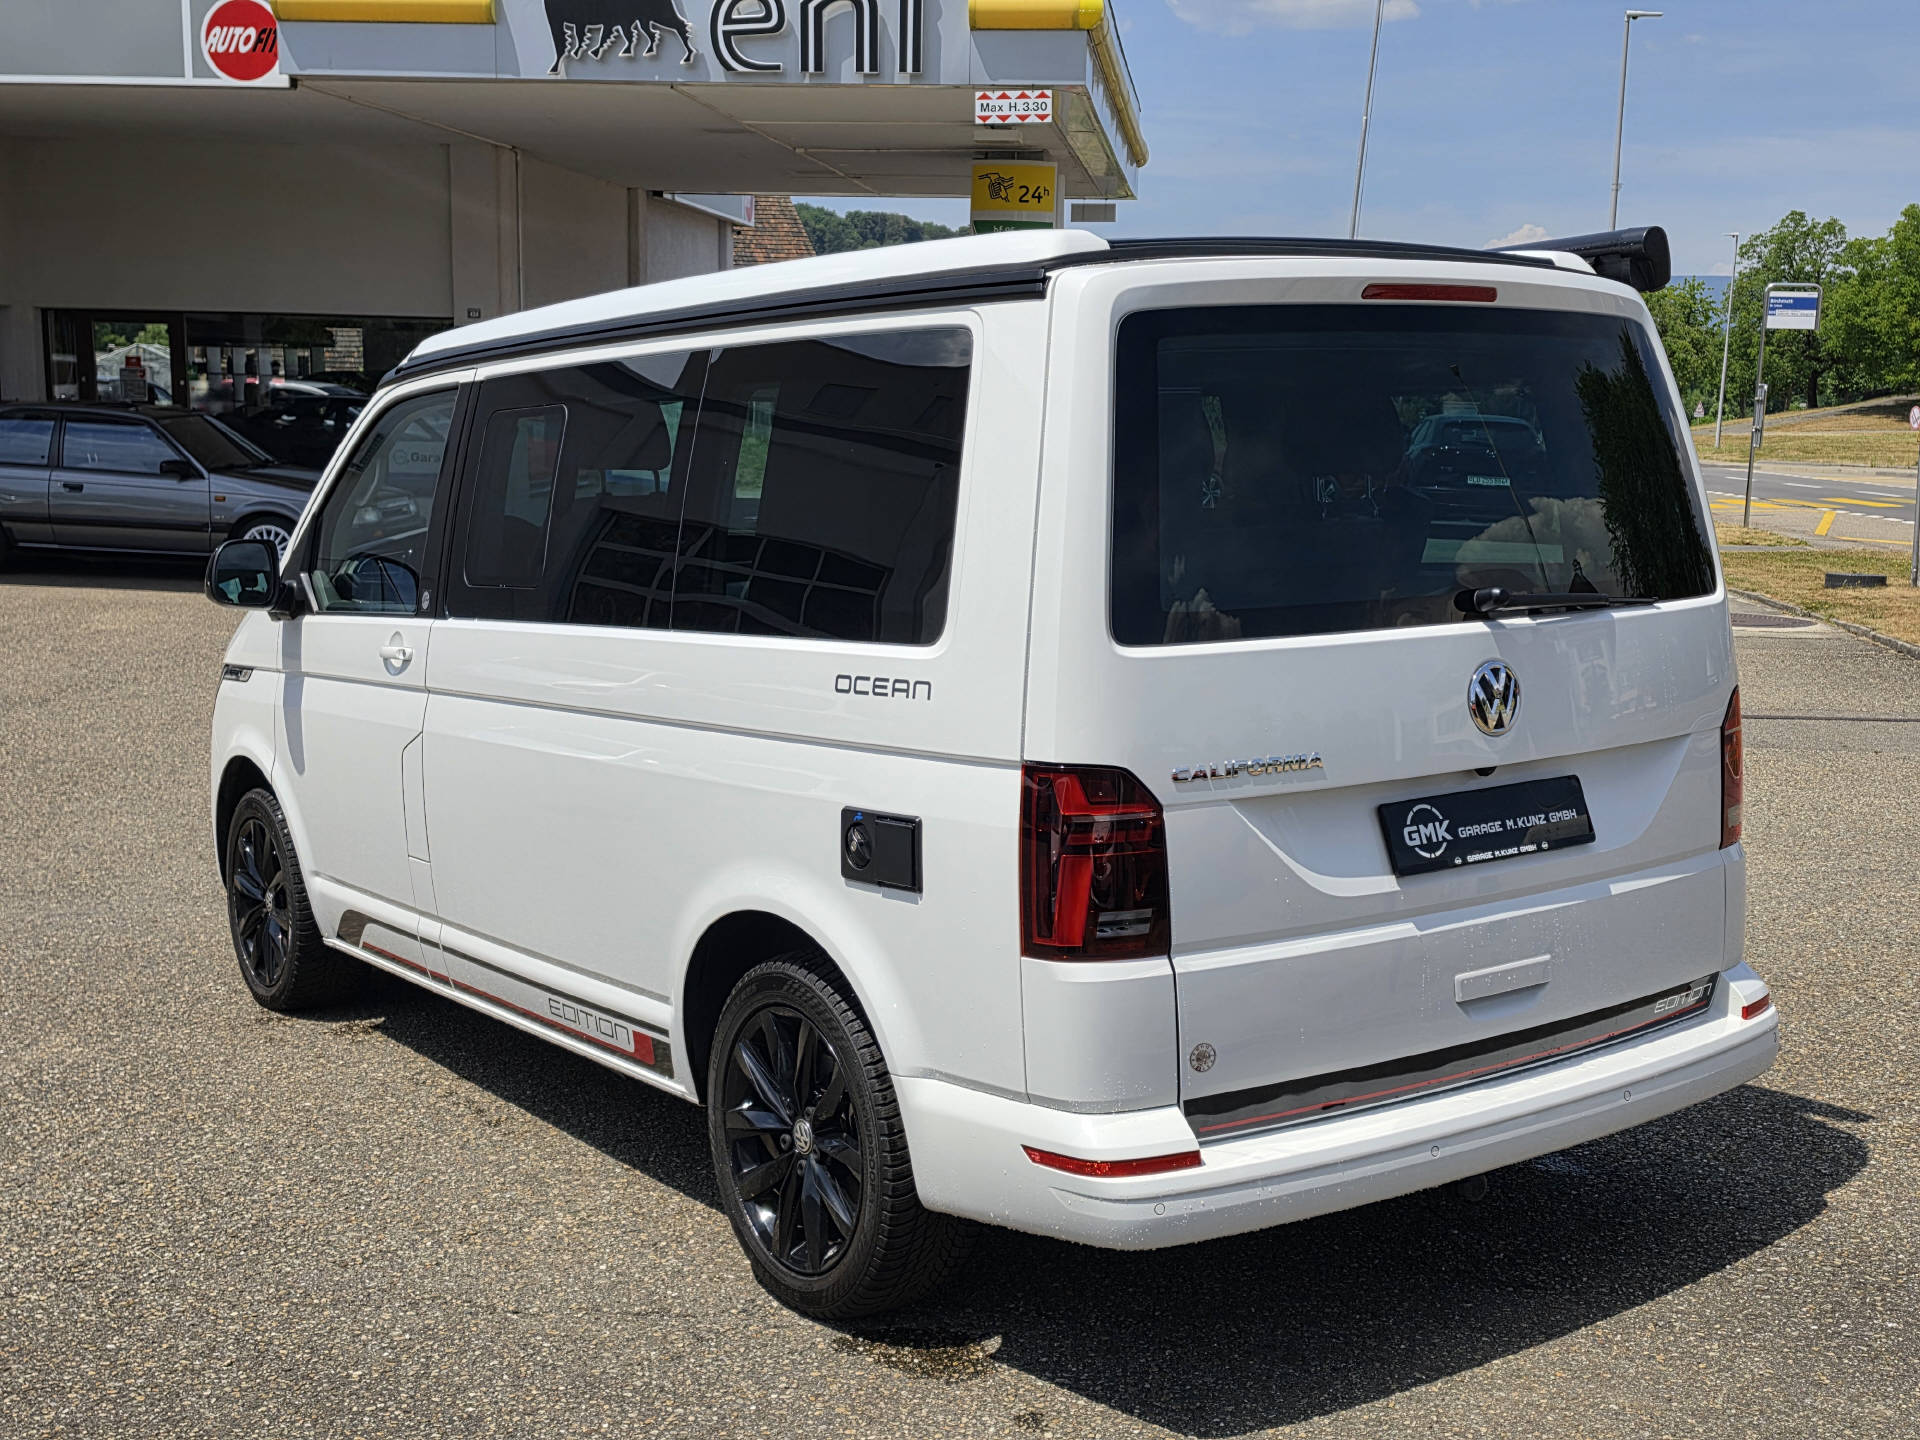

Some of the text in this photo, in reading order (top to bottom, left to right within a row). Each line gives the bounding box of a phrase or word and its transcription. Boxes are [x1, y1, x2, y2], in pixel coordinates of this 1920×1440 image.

[980, 101, 1048, 112] Max H. 3.30
[1018, 185, 1050, 204] 24h
[835, 674, 932, 701] OCEAN
[1171, 752, 1324, 783] CALIFORNIA
[1403, 808, 1577, 847] GMK GARAGE M.KUNZ GMBH
[1467, 851, 1494, 863] GARAGE
[1654, 983, 1712, 1014] EDITION
[548, 997, 631, 1046] EDITION
